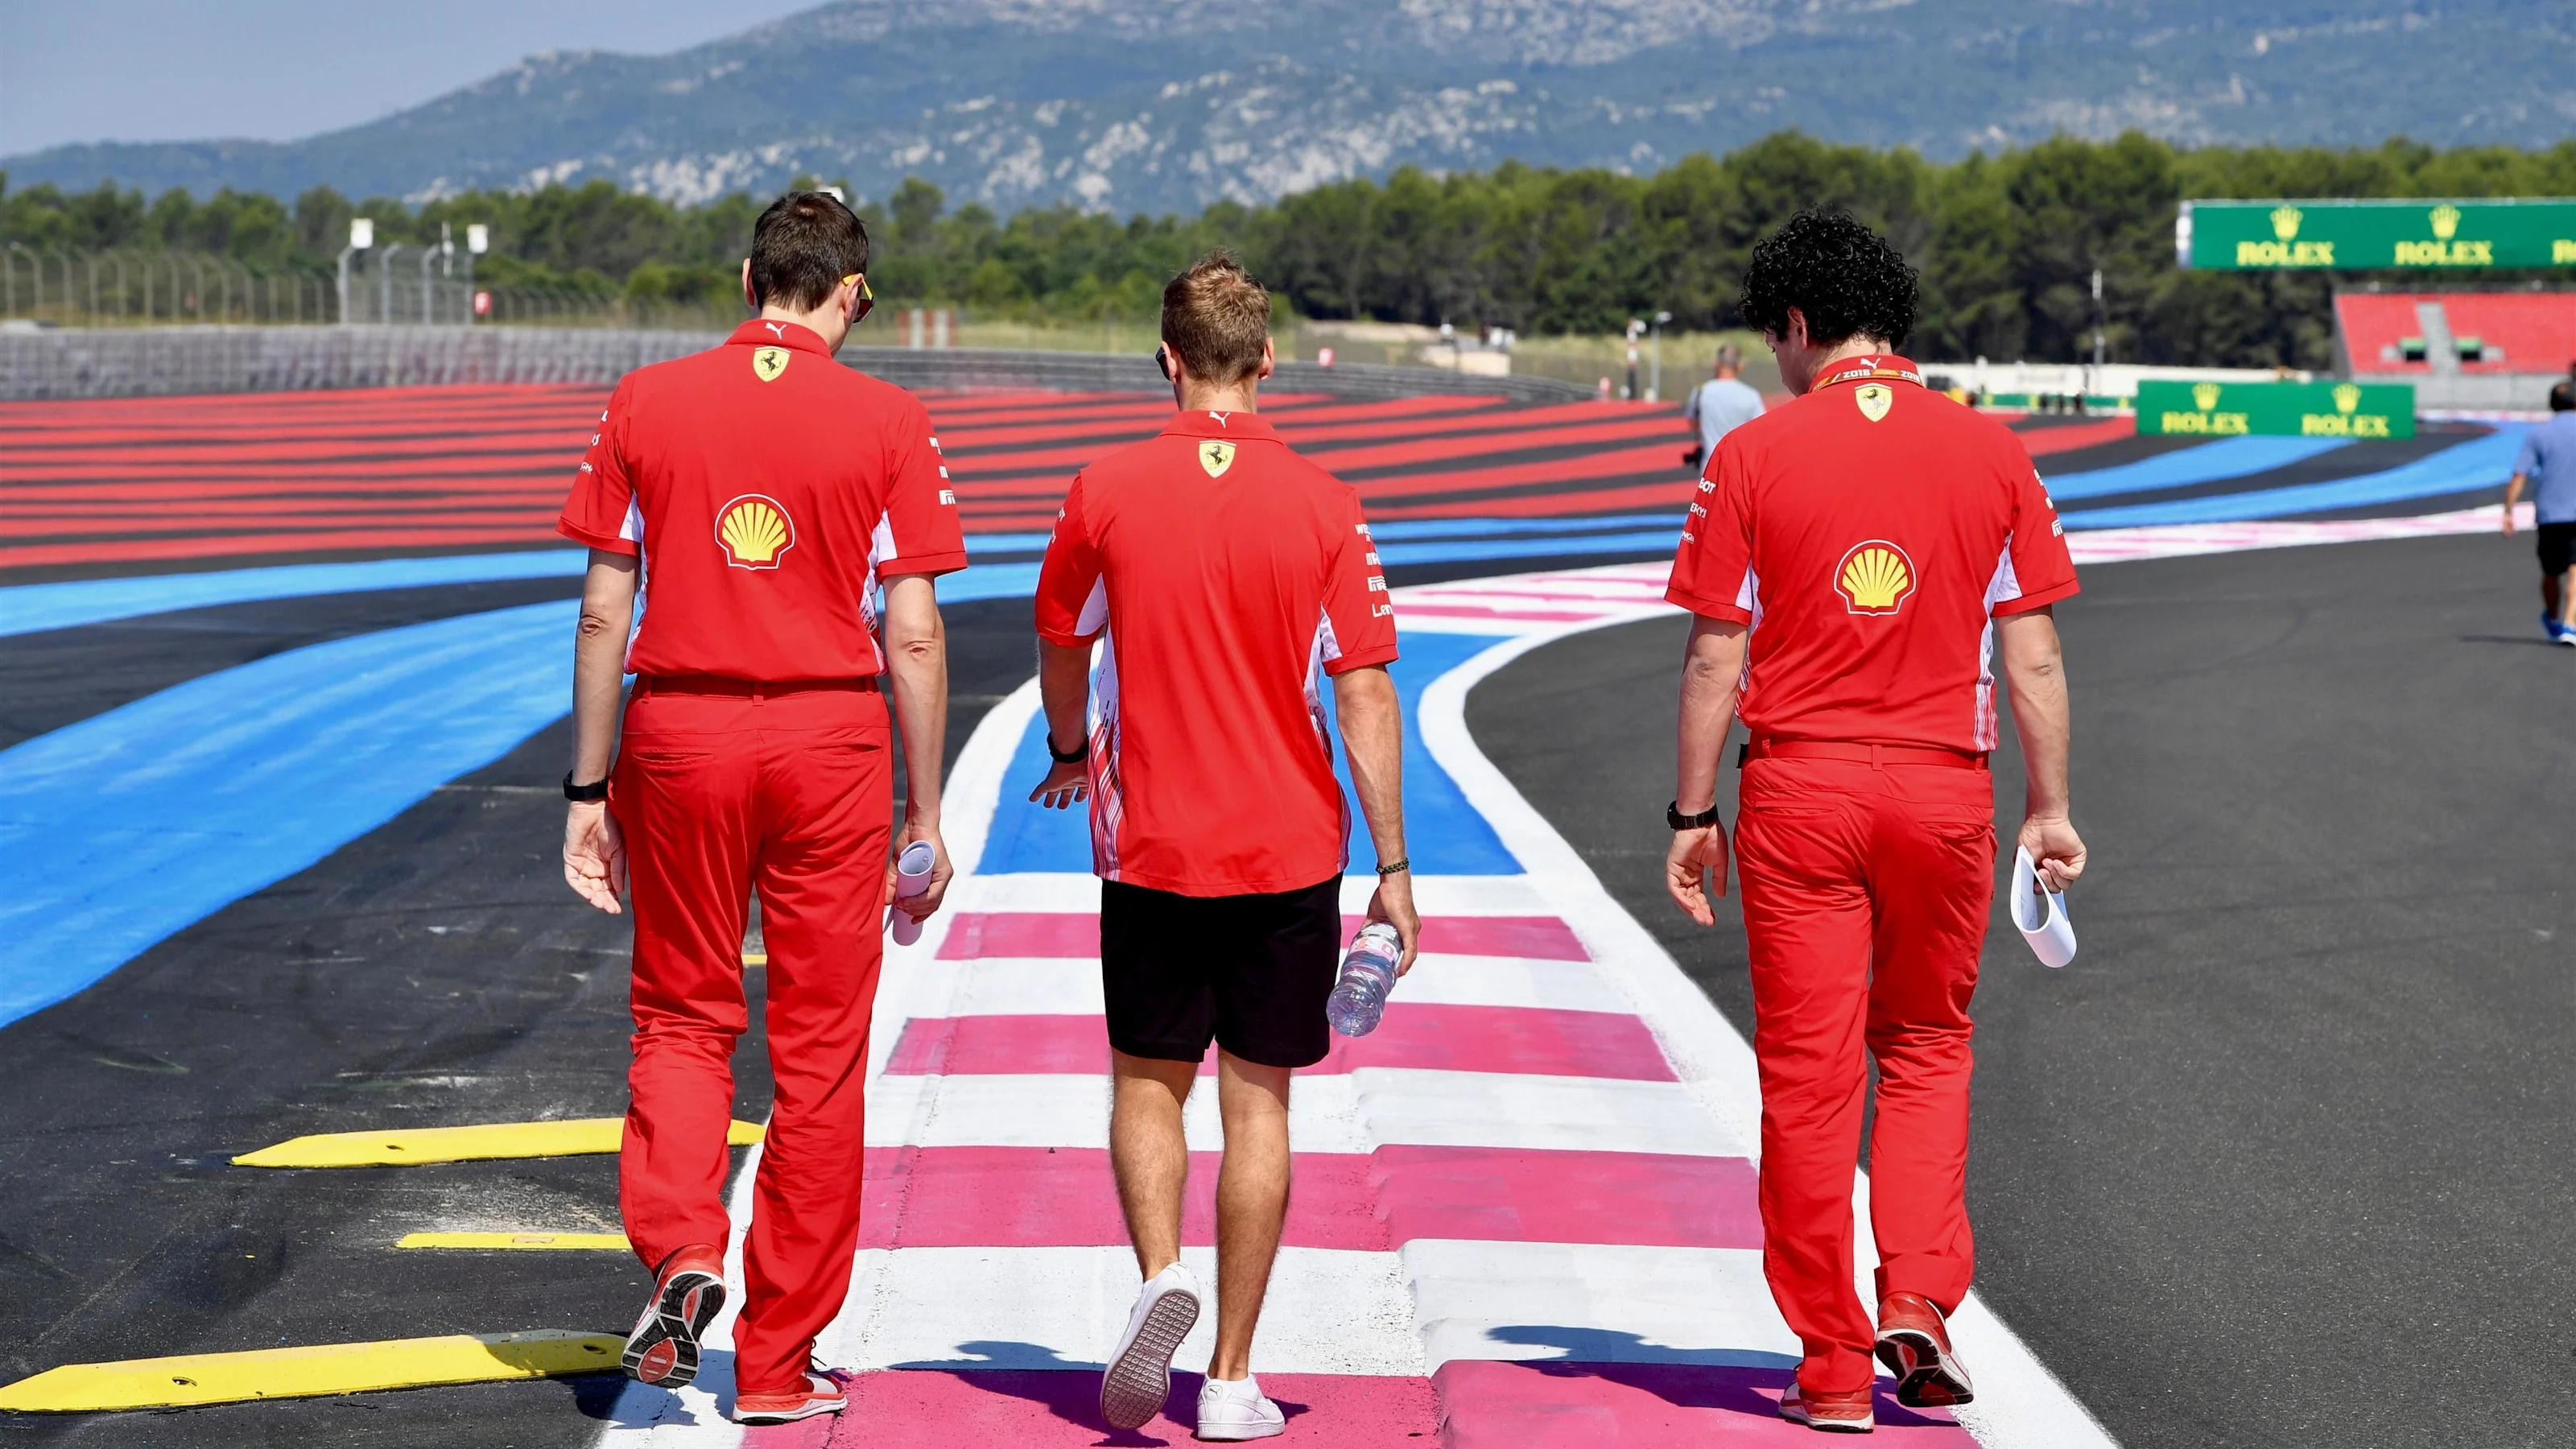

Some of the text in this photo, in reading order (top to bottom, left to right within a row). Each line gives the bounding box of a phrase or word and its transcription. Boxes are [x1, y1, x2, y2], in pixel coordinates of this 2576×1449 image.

[2236, 241, 2334, 266] ROLEX
[2394, 240, 2494, 266] ROLEX
[1843, 369, 1871, 379] 2018
[2161, 411, 2249, 435] ROLEX
[2301, 413, 2391, 437] ROLEX
